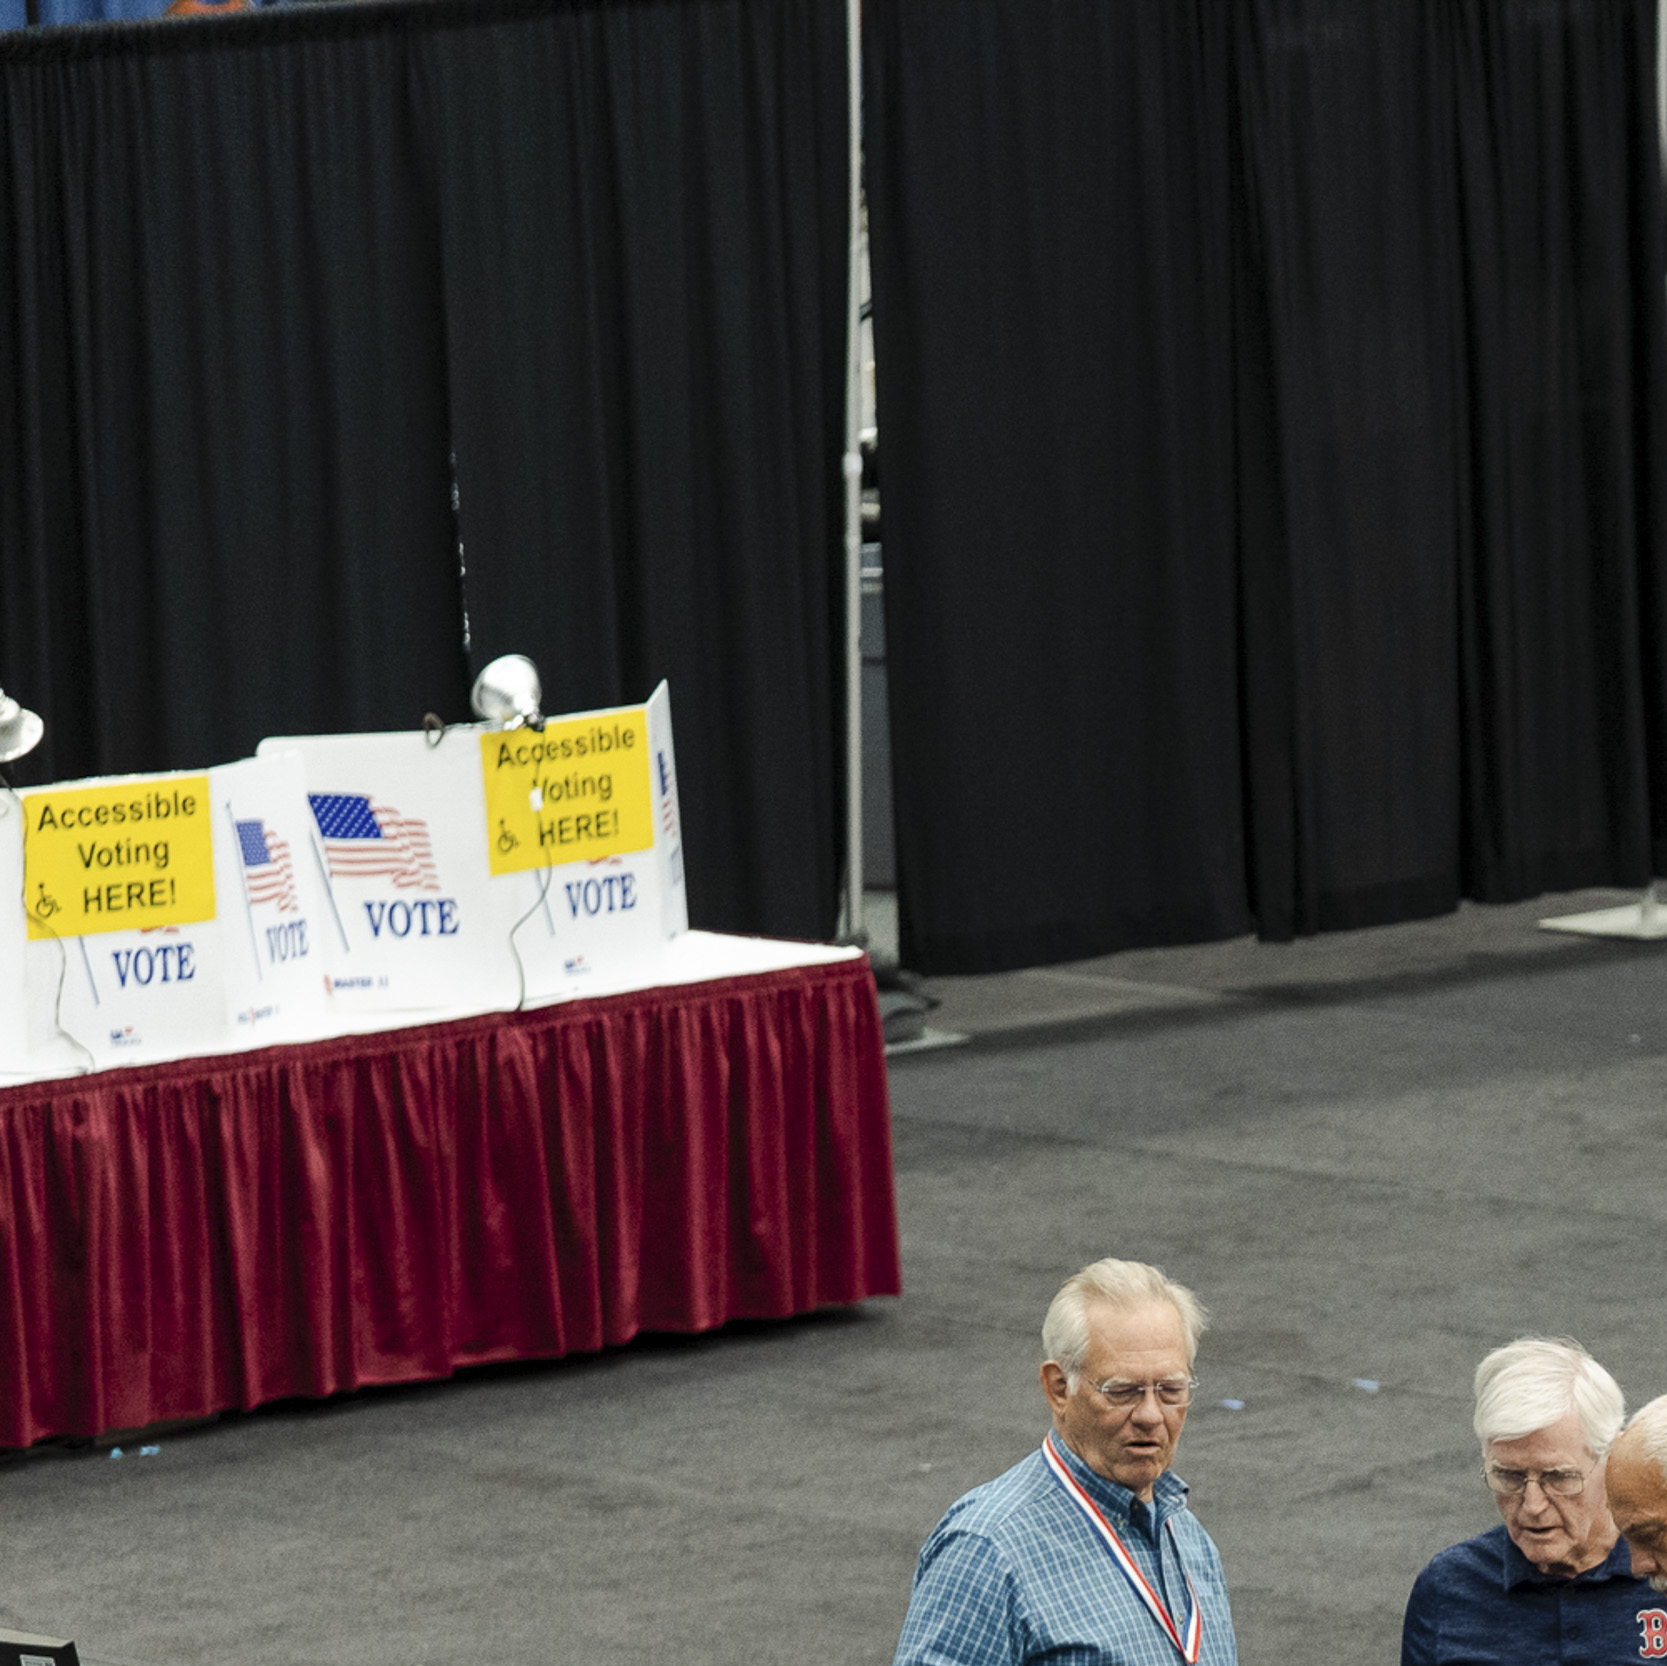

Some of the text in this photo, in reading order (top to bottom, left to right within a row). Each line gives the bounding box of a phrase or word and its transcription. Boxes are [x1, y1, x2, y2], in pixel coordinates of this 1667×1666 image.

[497, 724, 635, 770] Accessible
[533, 771, 613, 801] Voting
[37, 790, 197, 832] Accessible
[538, 808, 619, 847] HERE!
[77, 837, 169, 869] Voting
[83, 877, 176, 914] HERE!
[565, 871, 638, 919] VOTE
[363, 897, 460, 938] VOTE
[265, 918, 310, 964] VOTE
[111, 940, 196, 988] VOTE
